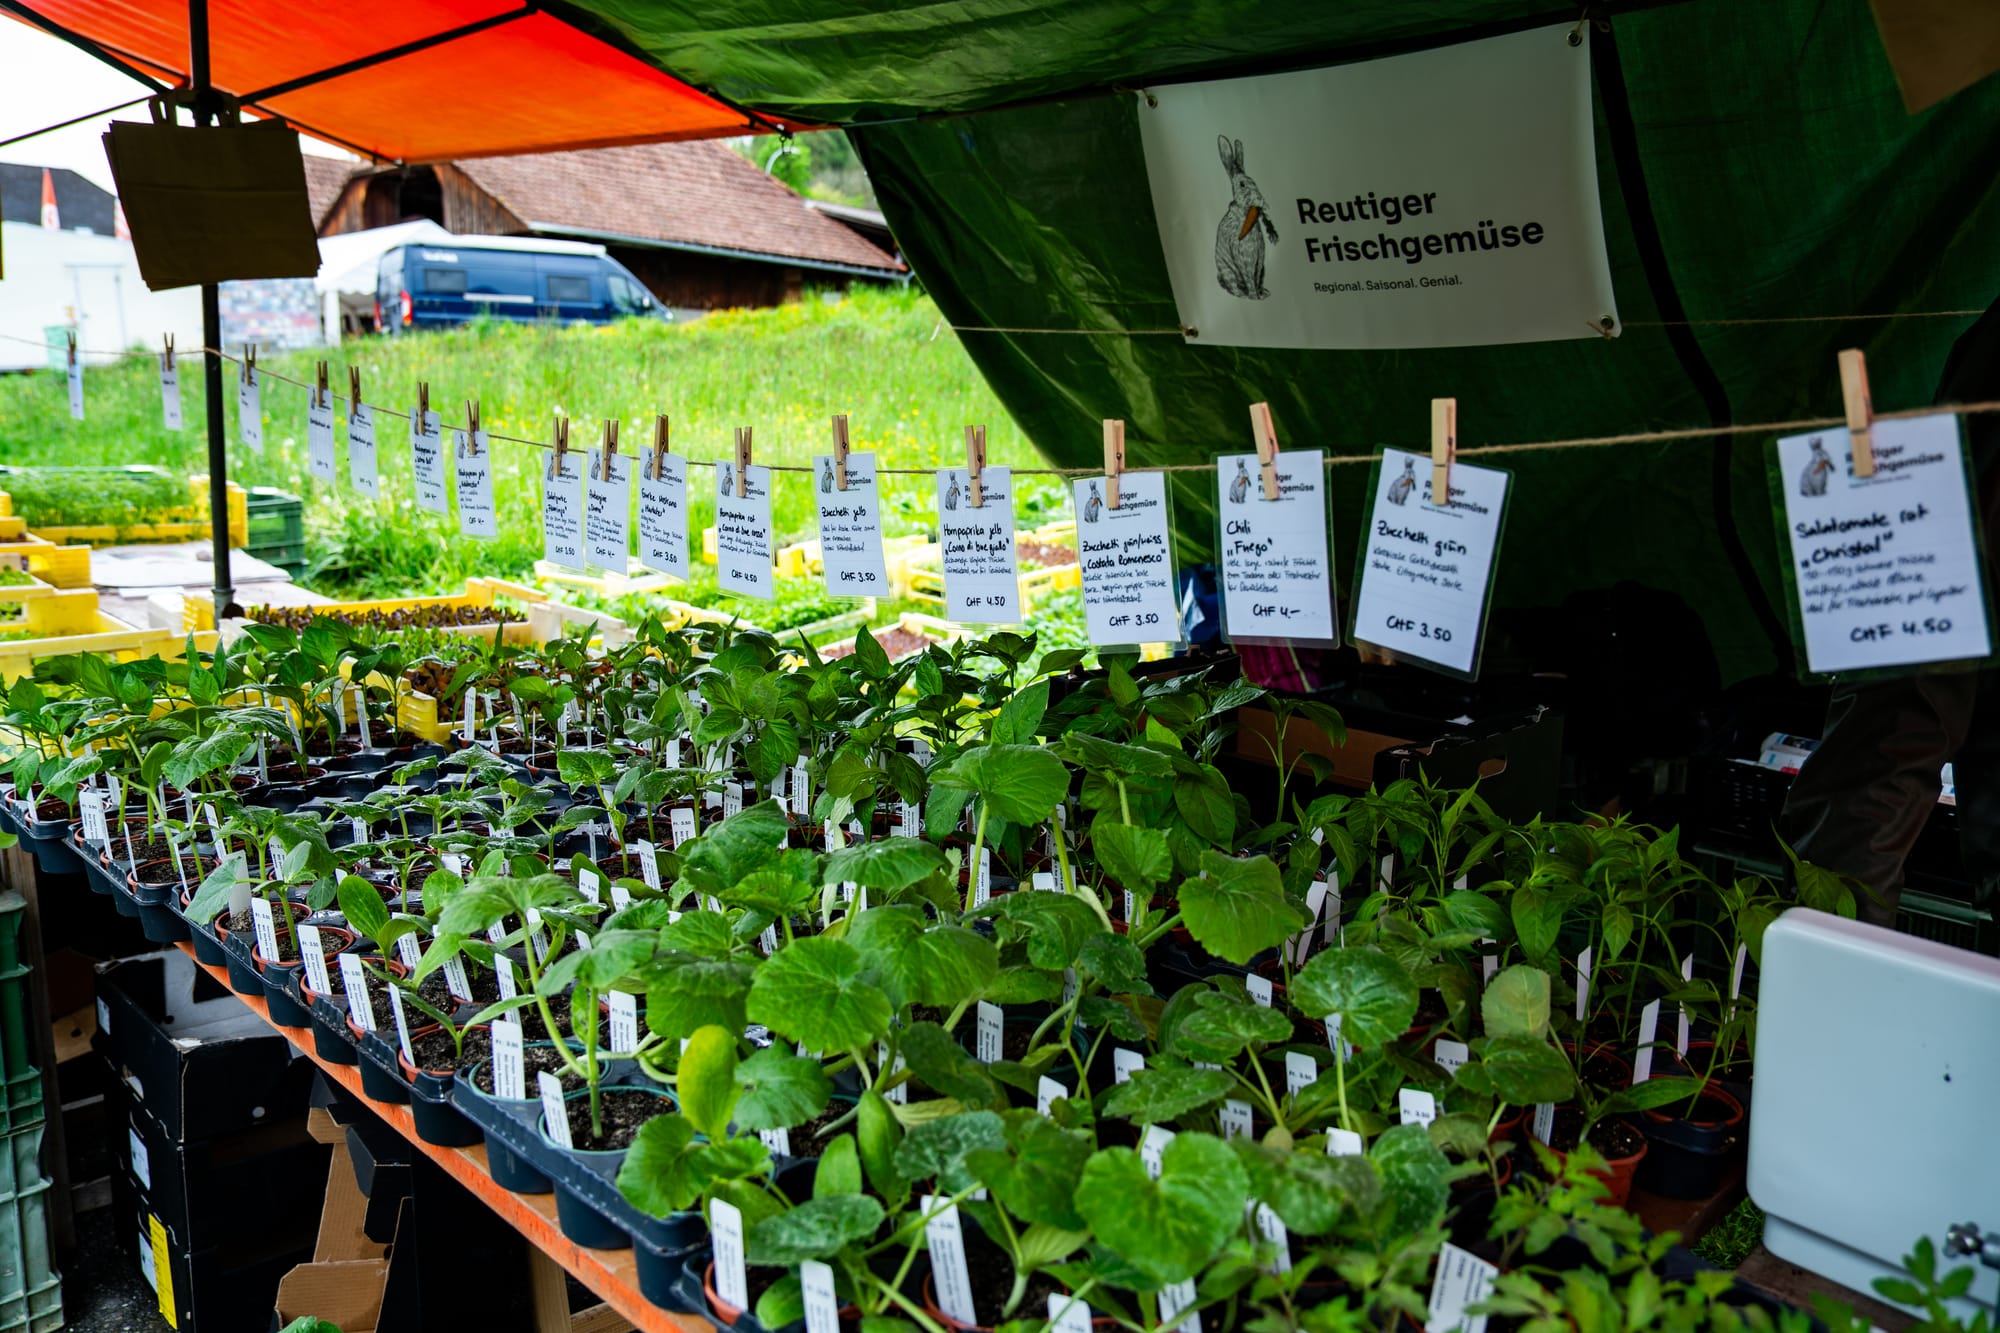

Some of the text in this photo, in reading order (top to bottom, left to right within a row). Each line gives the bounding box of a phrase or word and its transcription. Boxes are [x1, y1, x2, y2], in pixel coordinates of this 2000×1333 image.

[1296, 191, 1437, 225] Reutiger
[1304, 219, 1545, 264] Frischgemüse
[1313, 275, 1463, 294] Regional. Saisonal. Genial.
[821, 505, 867, 522] Zucchetti gelb
[1899, 503, 1929, 524] rot
[1226, 519, 1251, 535] Chili
[1082, 538, 1119, 552] Zucchetti
[1377, 519, 1467, 558] Zucchetti grün
[840, 570, 876, 583] CHF 3.50
[966, 595, 1006, 607] CHF 4.50
[1252, 603, 1275, 617] CHF
[1109, 612, 1159, 627] CHF 3.50
[1386, 614, 1452, 642] CHF 3.50
[1850, 617, 1953, 644] CHF 4.50
